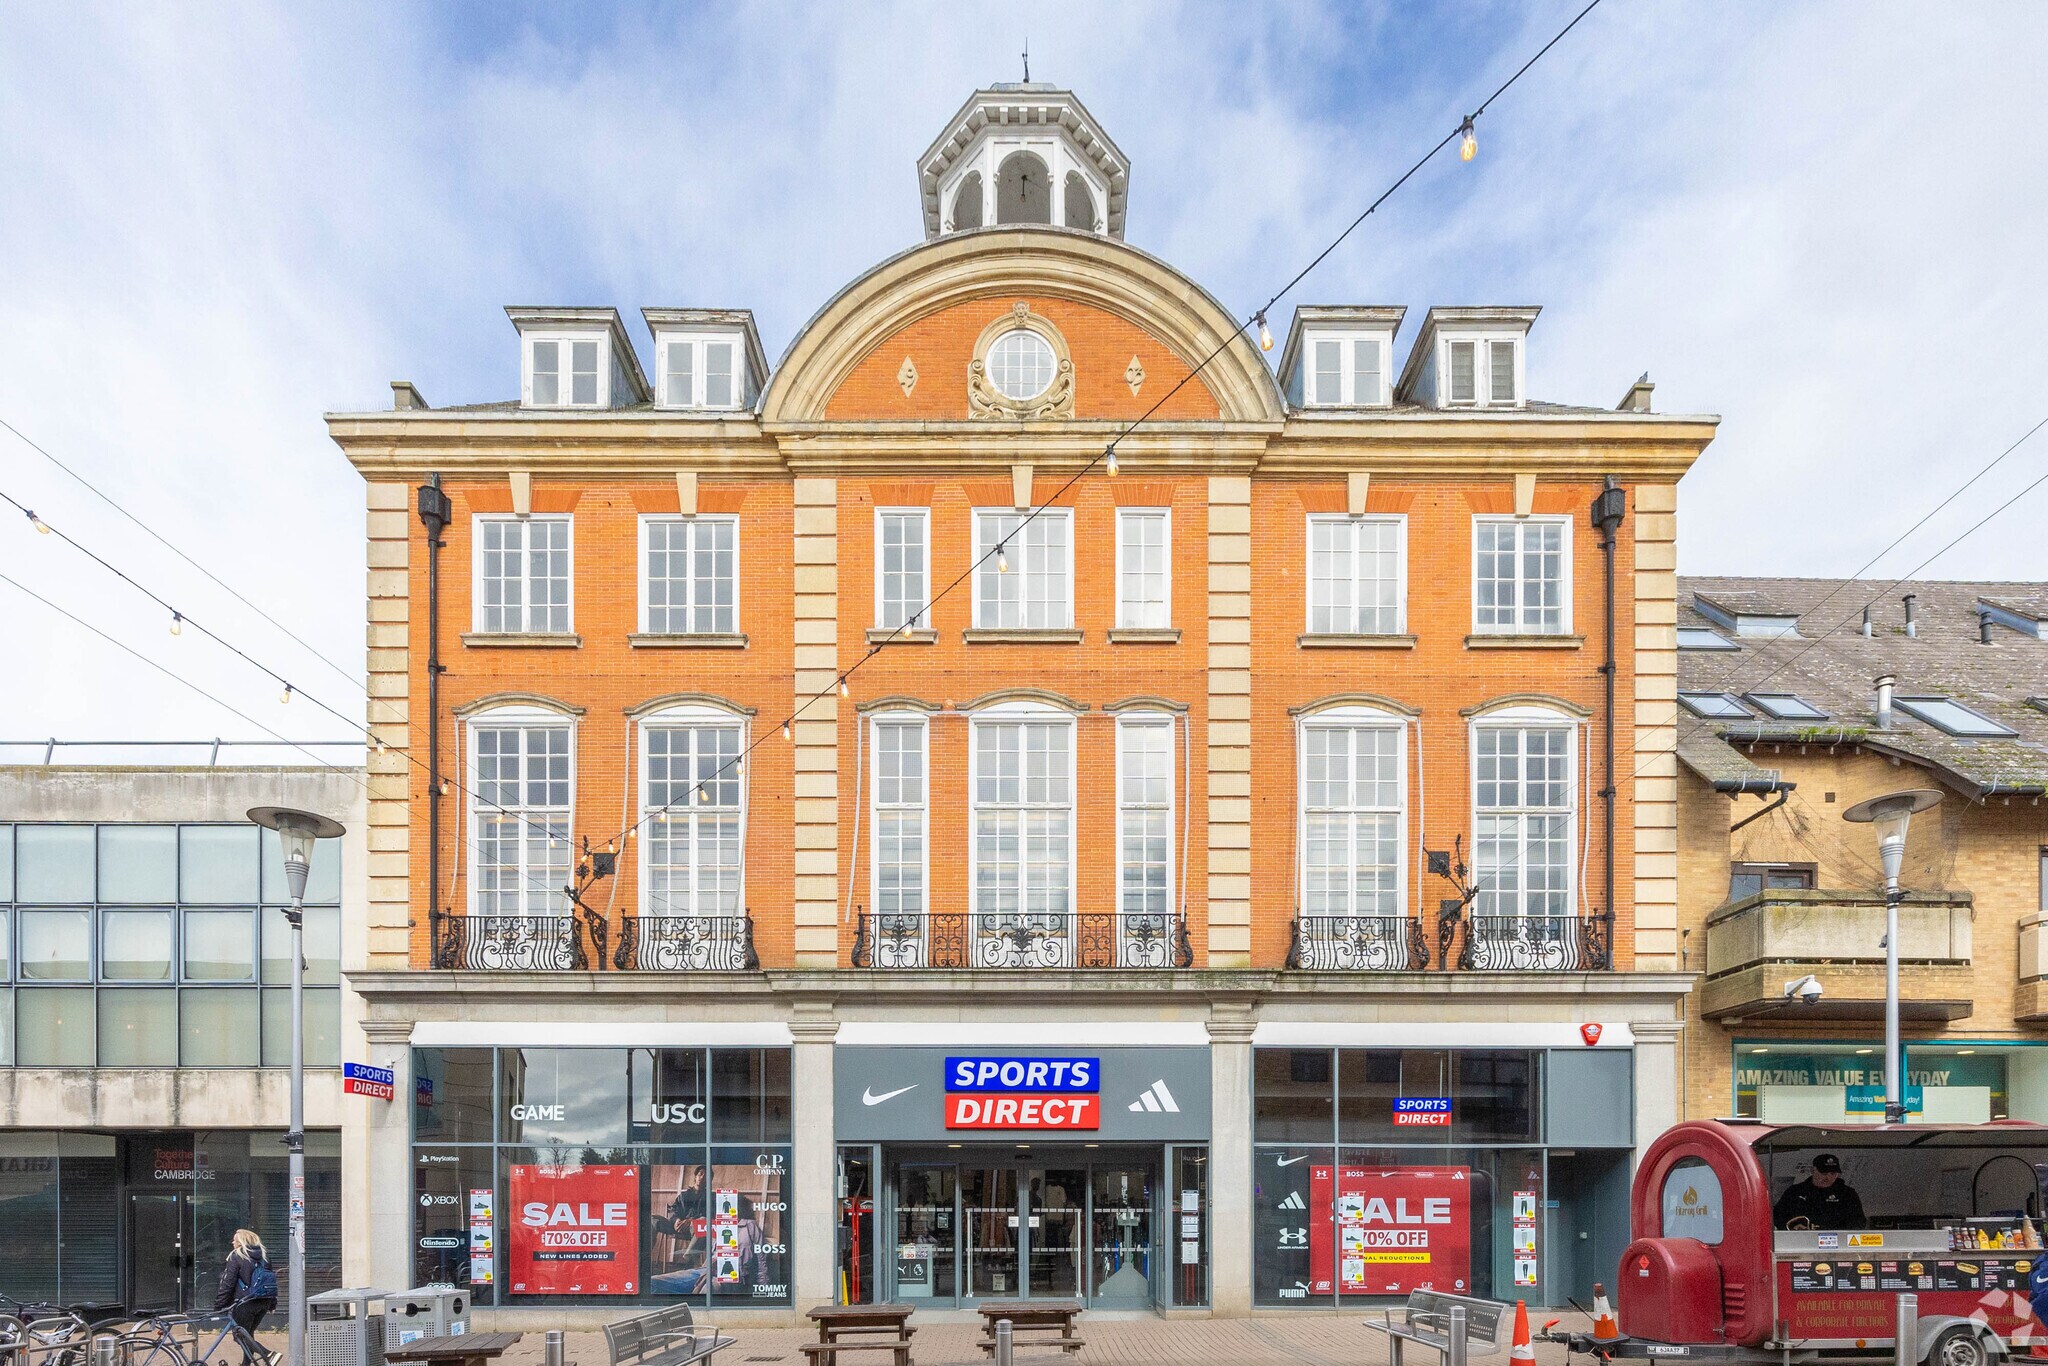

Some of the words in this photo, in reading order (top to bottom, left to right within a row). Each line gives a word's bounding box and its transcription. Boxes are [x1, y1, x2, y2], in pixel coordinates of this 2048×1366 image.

[353, 1065, 393, 1082] SPORTS
[954, 1060, 1091, 1087] SPORTS
[1737, 1069, 1809, 1086] AMAZING
[1815, 1069, 1864, 1086] VALUE
[1869, 1070, 1950, 1086] EVYDAY
[353, 1081, 393, 1097] DIRECT
[1398, 1100, 1448, 1110] SPORTS
[1849, 1095, 1873, 1104] Amazing
[510, 1104, 565, 1121] GAME
[651, 1103, 706, 1124] USC
[954, 1098, 1090, 1125] DIRECT
[1398, 1114, 1447, 1124] DIRECT
[756, 1154, 784, 1169] C.P.
[154, 1169, 216, 1180] CAMBRIDGE
[753, 1168, 787, 1176] COMPANY
[433, 1196, 459, 1204] XBOX
[752, 1202, 787, 1212] HUGO
[1329, 1197, 1451, 1224] ALE
[521, 1202, 628, 1227] SALE
[546, 1232, 576, 1245] 70%
[579, 1232, 606, 1245] OFF
[1396, 1231, 1426, 1246] OFF
[753, 1244, 787, 1254] BOSS
[752, 1284, 787, 1293] TOMMY
[1279, 1288, 1306, 1298] PUMA
[1796, 1299, 1836, 1311] AVAILABLE
[1838, 1299, 1854, 1311] FOR
[1856, 1299, 1887, 1311] PRIVATE
[1795, 1316, 1803, 1327] &
[1805, 1316, 1850, 1327] CORPORATE
[1852, 1316, 1889, 1327] FUNCTIONS
